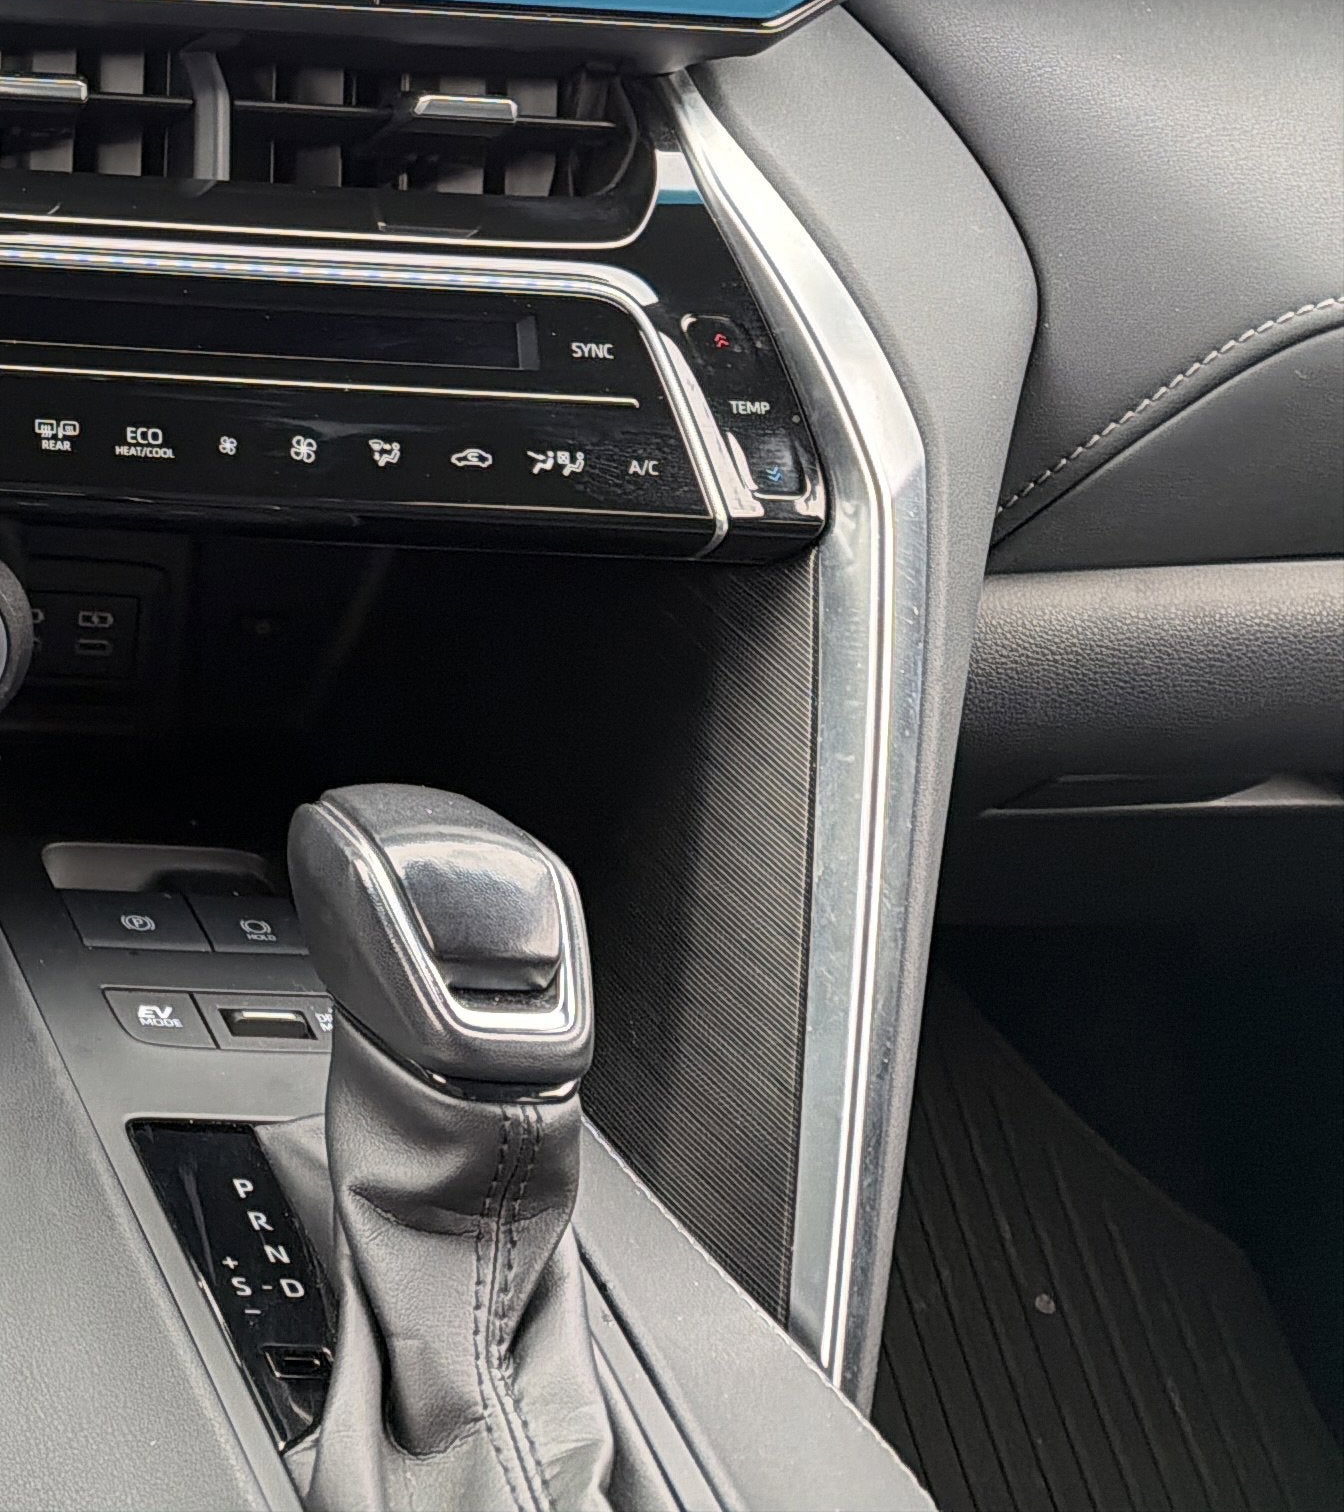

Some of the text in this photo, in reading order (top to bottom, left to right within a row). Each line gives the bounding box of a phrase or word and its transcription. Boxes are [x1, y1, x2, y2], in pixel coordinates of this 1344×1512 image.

[571, 342, 615, 359] SYNC
[729, 400, 771, 415] TEMP
[126, 426, 163, 445] ECO
[41, 439, 72, 452] REAR
[114, 445, 176, 459] HEAT/COOL
[628, 459, 661, 476] A/C
[247, 933, 277, 942] HOLD
[137, 1004, 173, 1019] EV
[139, 1017, 183, 1028] MODE
[232, 1178, 254, 1199] P
[247, 1211, 274, 1232] R
[264, 1244, 291, 1264] N
